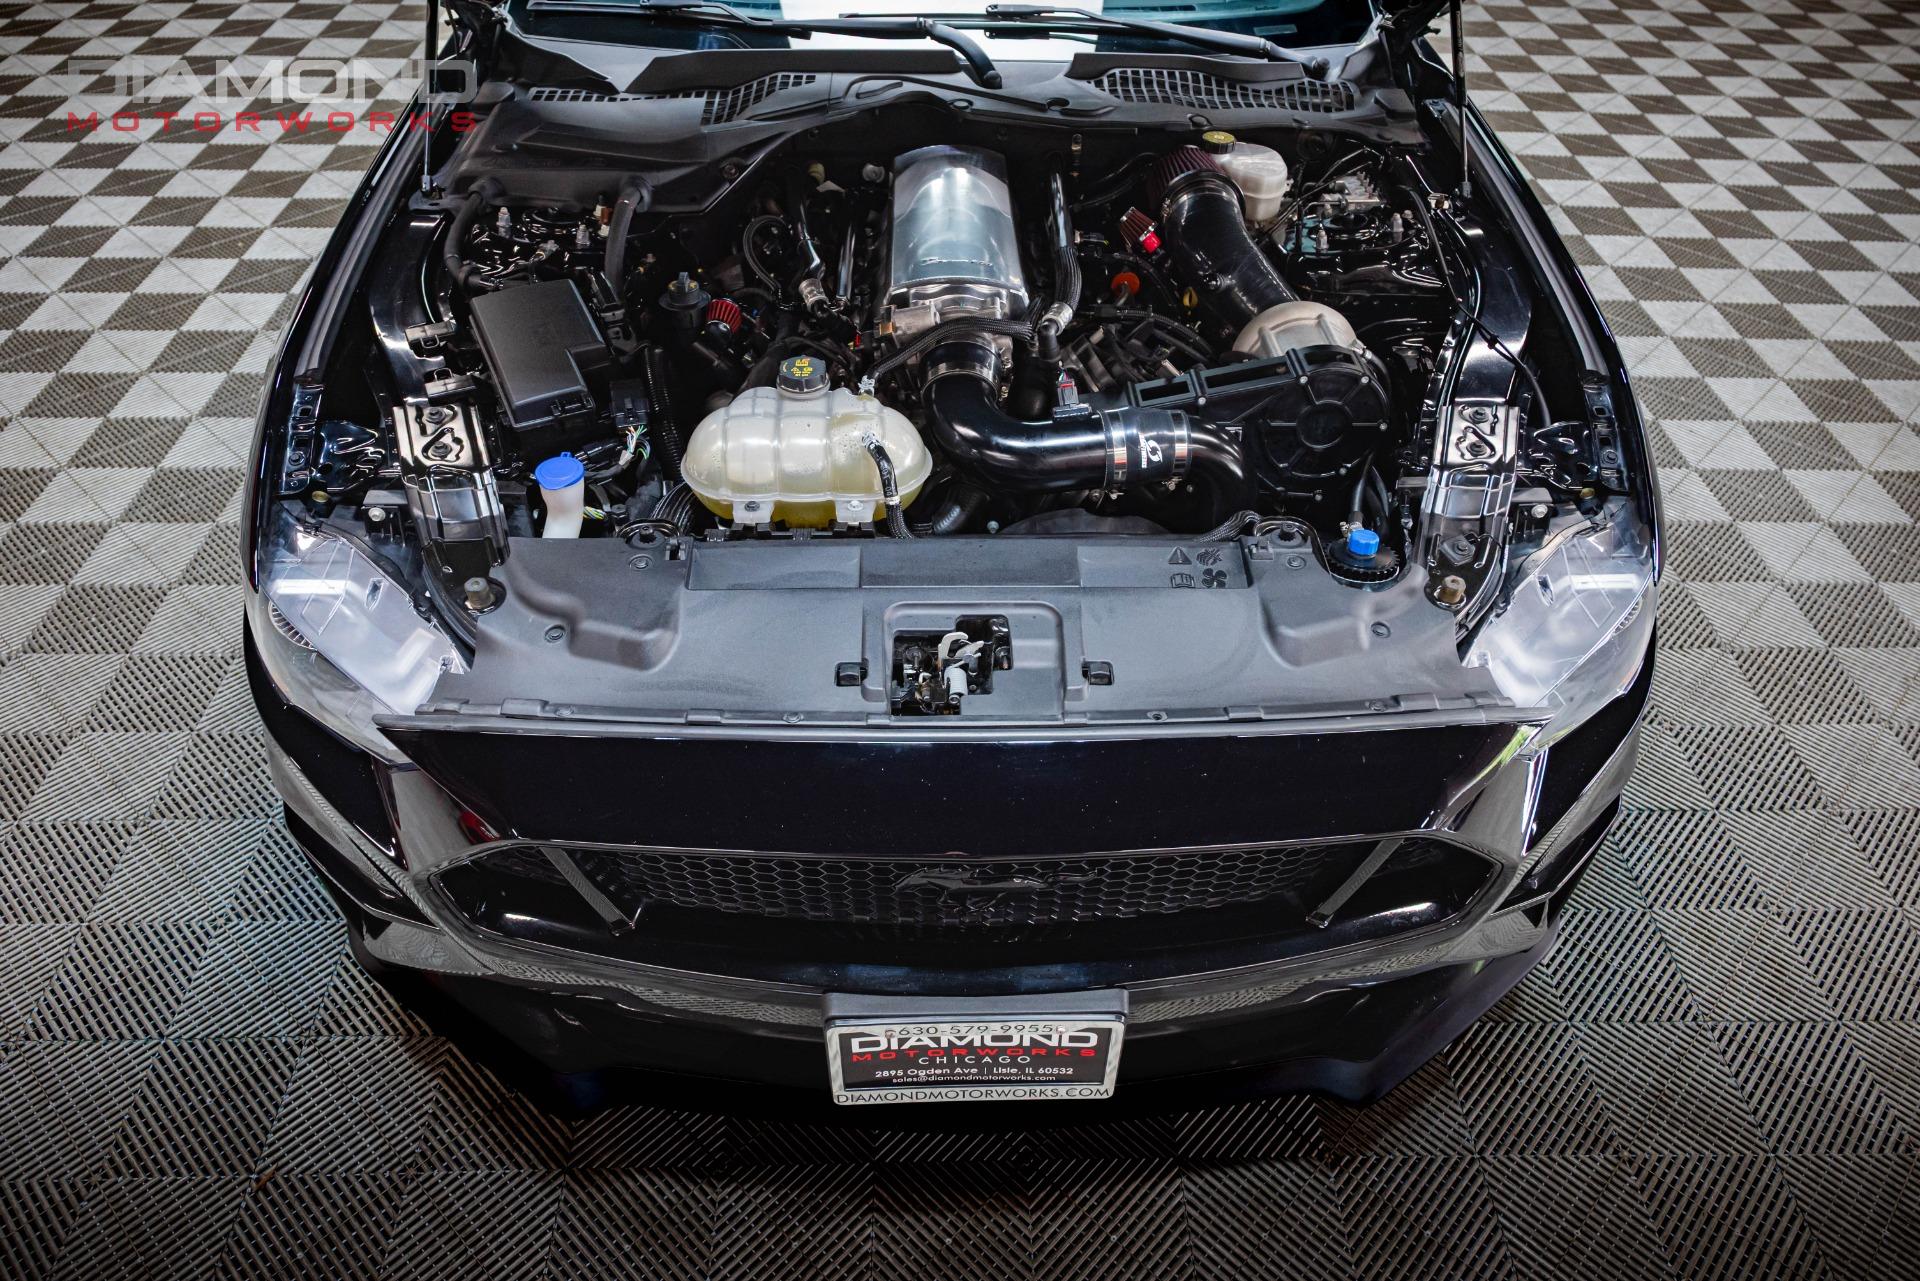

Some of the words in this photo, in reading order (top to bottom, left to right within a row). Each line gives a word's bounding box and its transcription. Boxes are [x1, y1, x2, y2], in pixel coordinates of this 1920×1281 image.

[898, 1024, 1054, 1036] 630-579-9955
[851, 1030, 1099, 1054] DIAMOND
[851, 1047, 1097, 1063] MOTORWORKS
[918, 1055, 1031, 1065] CHICAGO
[875, 1069, 904, 1078] 2895
[907, 1067, 950, 1077] Ogden
[953, 1066, 978, 1075] Ave
[1025, 1066, 1035, 1075] IL
[1037, 1067, 1074, 1075] 60532
[892, 1074, 1056, 1084] sales@diamondmotorworks.com
[836, 1087, 1110, 1104] DIAMONDMOTORWORKS.COM
